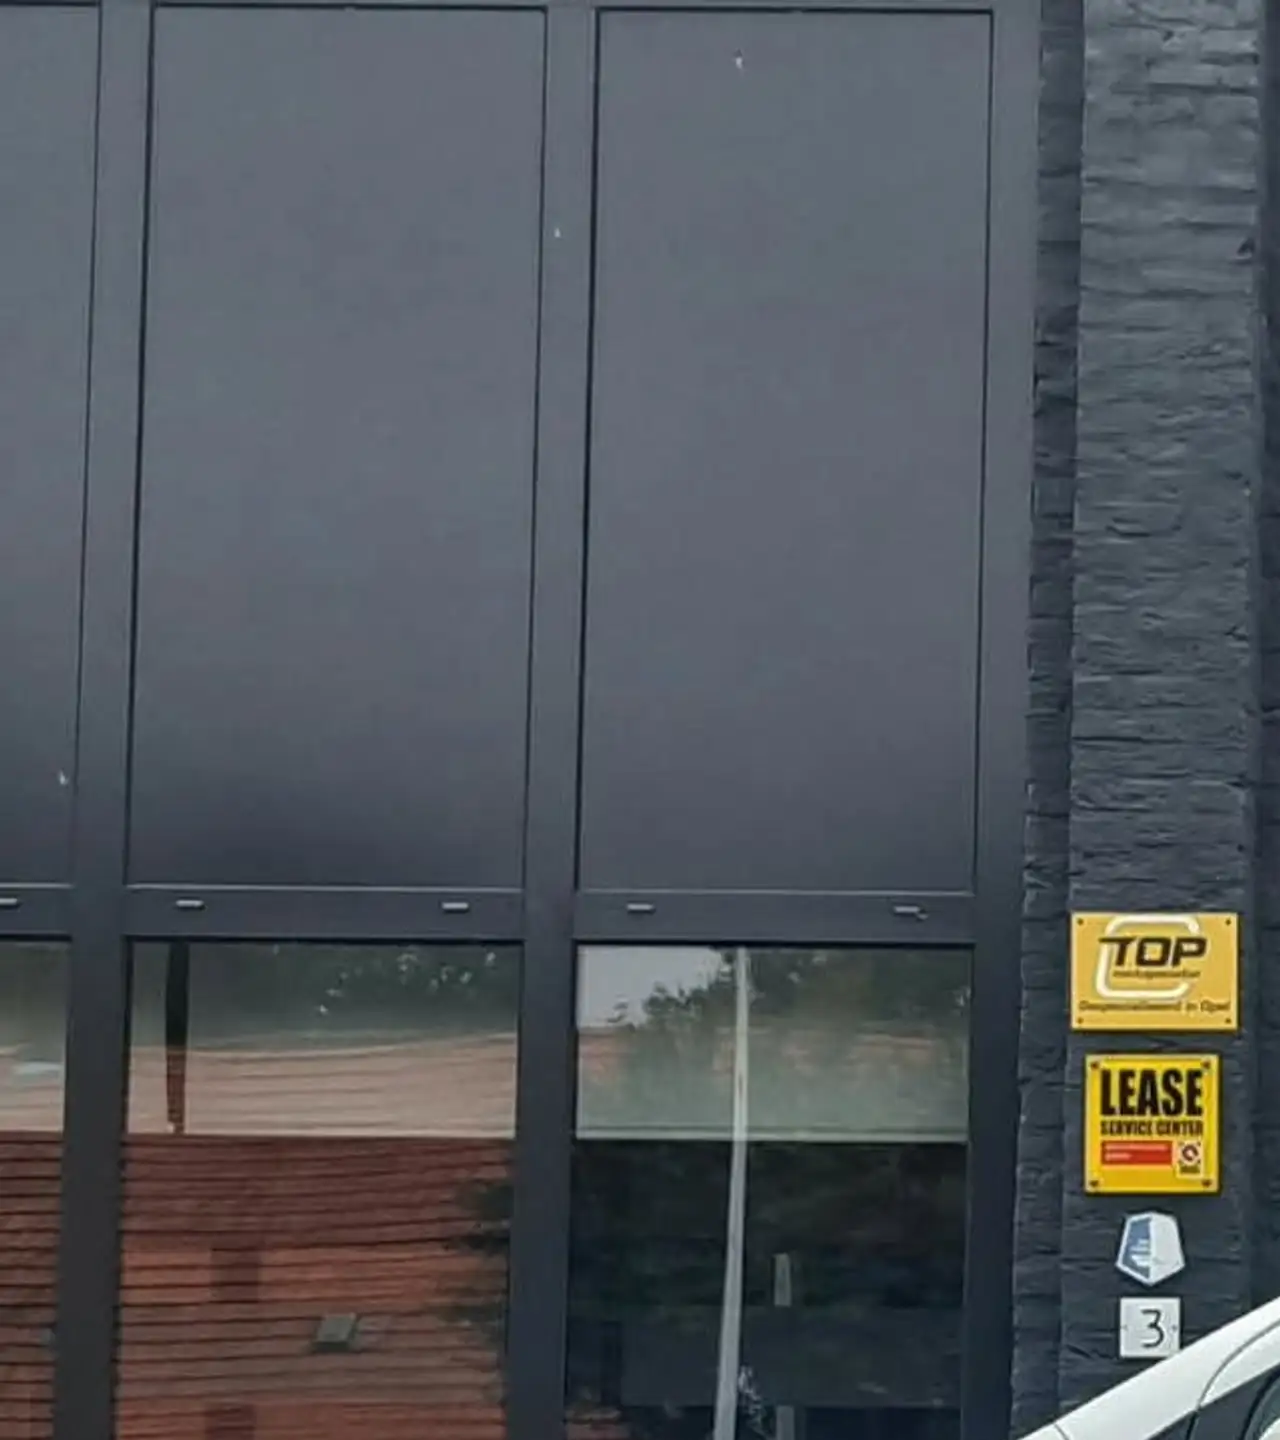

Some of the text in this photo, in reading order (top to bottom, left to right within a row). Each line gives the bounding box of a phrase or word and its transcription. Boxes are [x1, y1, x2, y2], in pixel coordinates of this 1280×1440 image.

[1098, 936, 1207, 967] TOP
[1100, 1068, 1204, 1116] LEASE
[1100, 1120, 1204, 1136] SERVICE CENTER
[1141, 1308, 1165, 1348] 3
